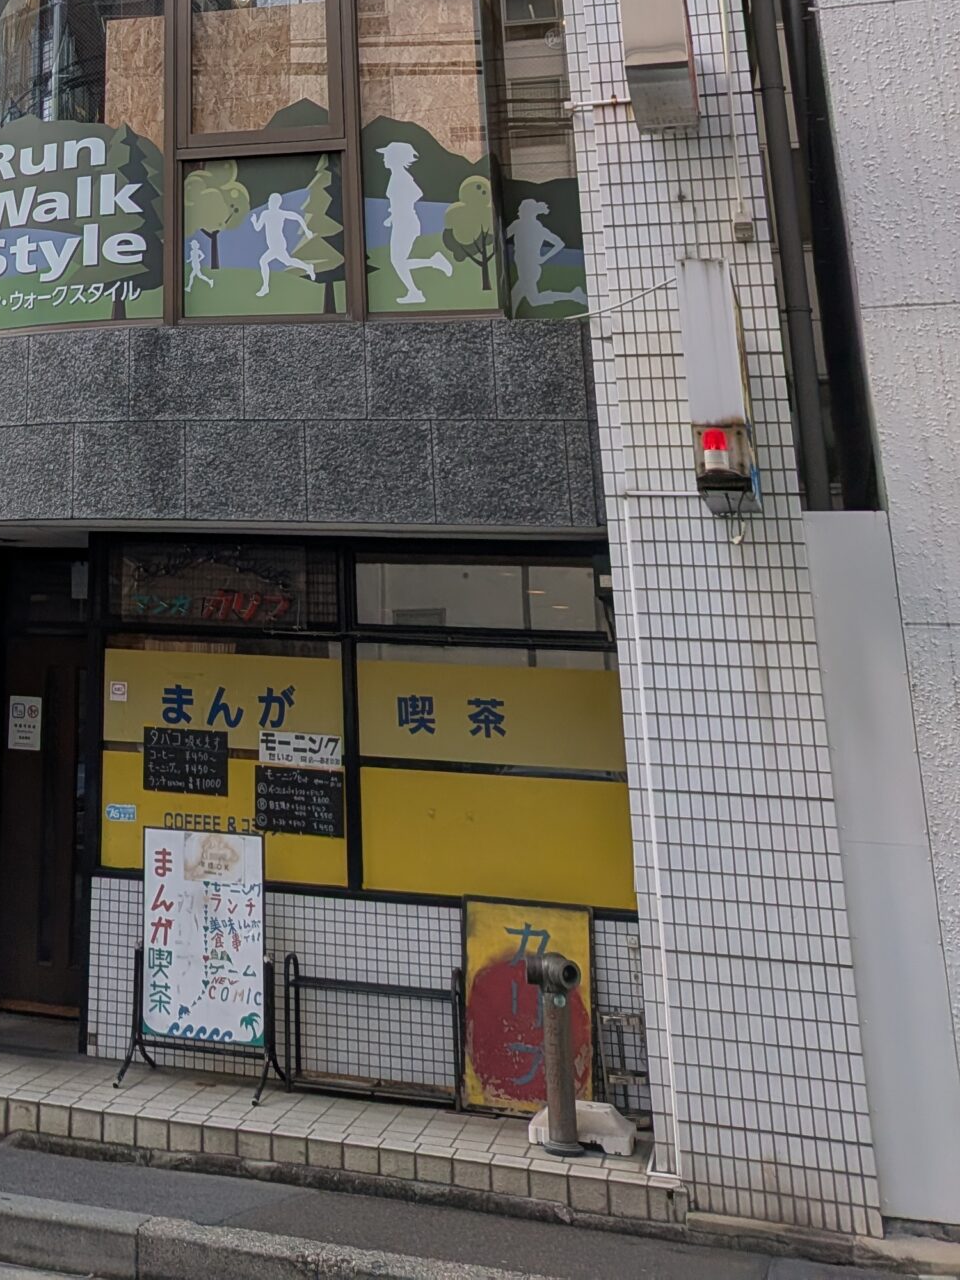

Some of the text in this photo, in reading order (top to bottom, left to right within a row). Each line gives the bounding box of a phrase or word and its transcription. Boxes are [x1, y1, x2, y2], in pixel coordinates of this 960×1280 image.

[161, 683, 295, 729] まんが
[397, 694, 506, 738] 喫茶
[150, 729, 181, 746] タバコ
[164, 812, 221, 832] COFFEE
[210, 893, 256, 917] ランチ
[210, 975, 240, 986] NEW
[208, 985, 262, 1007] COMIC
